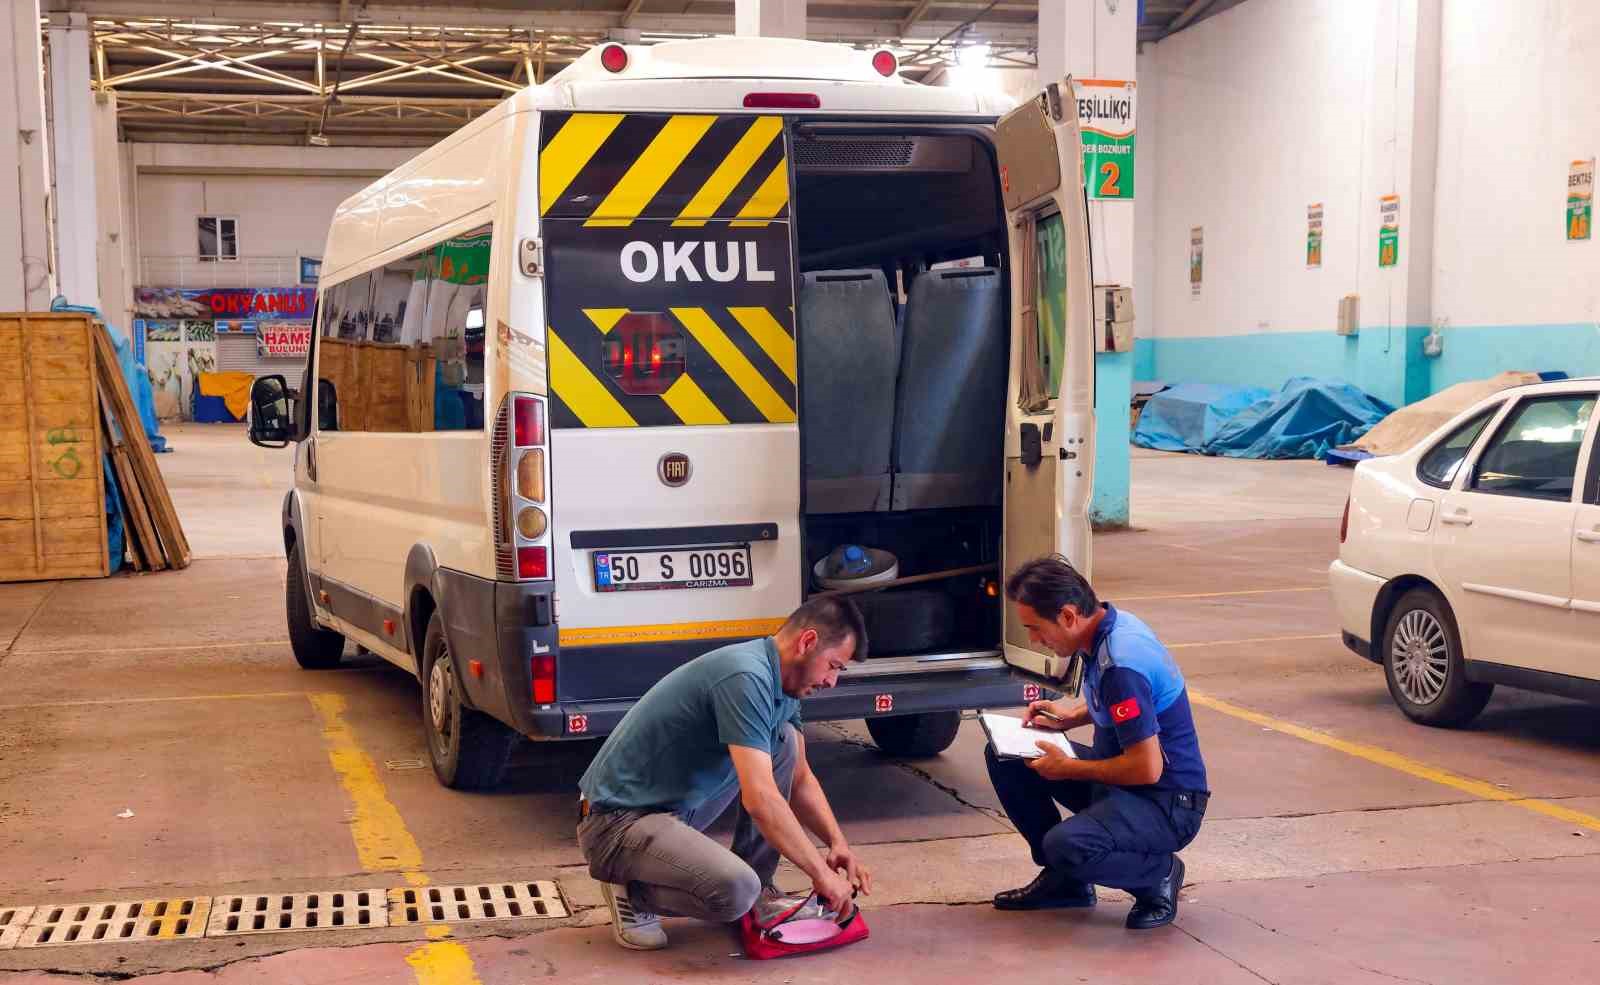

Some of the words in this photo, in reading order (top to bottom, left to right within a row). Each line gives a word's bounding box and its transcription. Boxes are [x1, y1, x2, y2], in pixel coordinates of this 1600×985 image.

[1076, 95, 1131, 124] EŞİLLİKÇİ
[1100, 162, 1120, 196] 2
[620, 241, 776, 283] OKUL
[667, 461, 688, 478] FIAT
[600, 571, 609, 580] TR
[611, 556, 639, 581] 50
[660, 554, 674, 580] S
[689, 551, 746, 578] 0096
